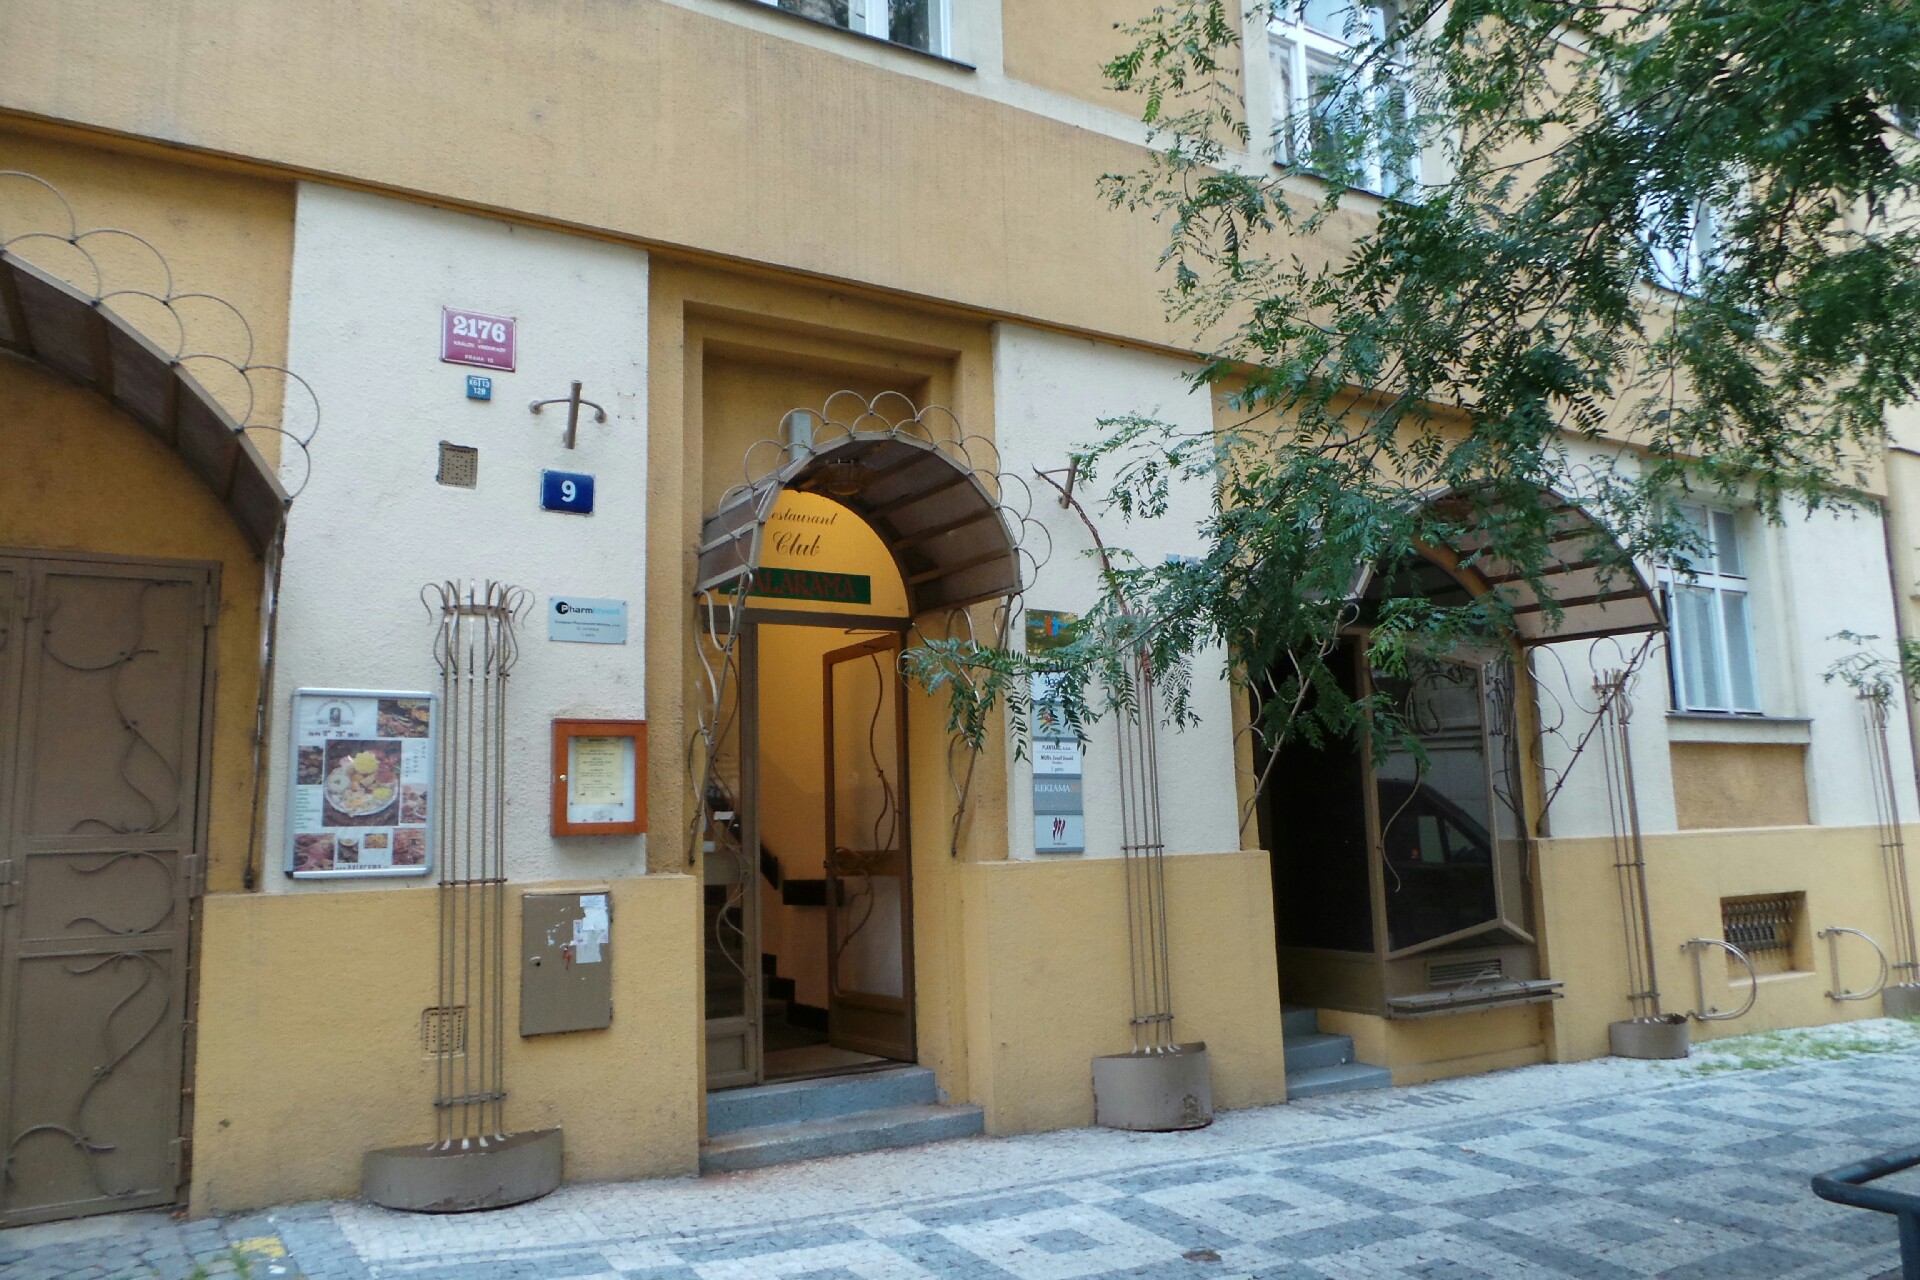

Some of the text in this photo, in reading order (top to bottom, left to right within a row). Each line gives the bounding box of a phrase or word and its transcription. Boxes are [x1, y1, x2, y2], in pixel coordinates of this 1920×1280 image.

[453, 315, 506, 343] 2176
[561, 480, 576, 503] 9
[771, 508, 838, 526] estaurant
[773, 531, 820, 557] Club
[749, 571, 856, 599] ALARAMA
[1034, 784, 1070, 793] REKLAMA
